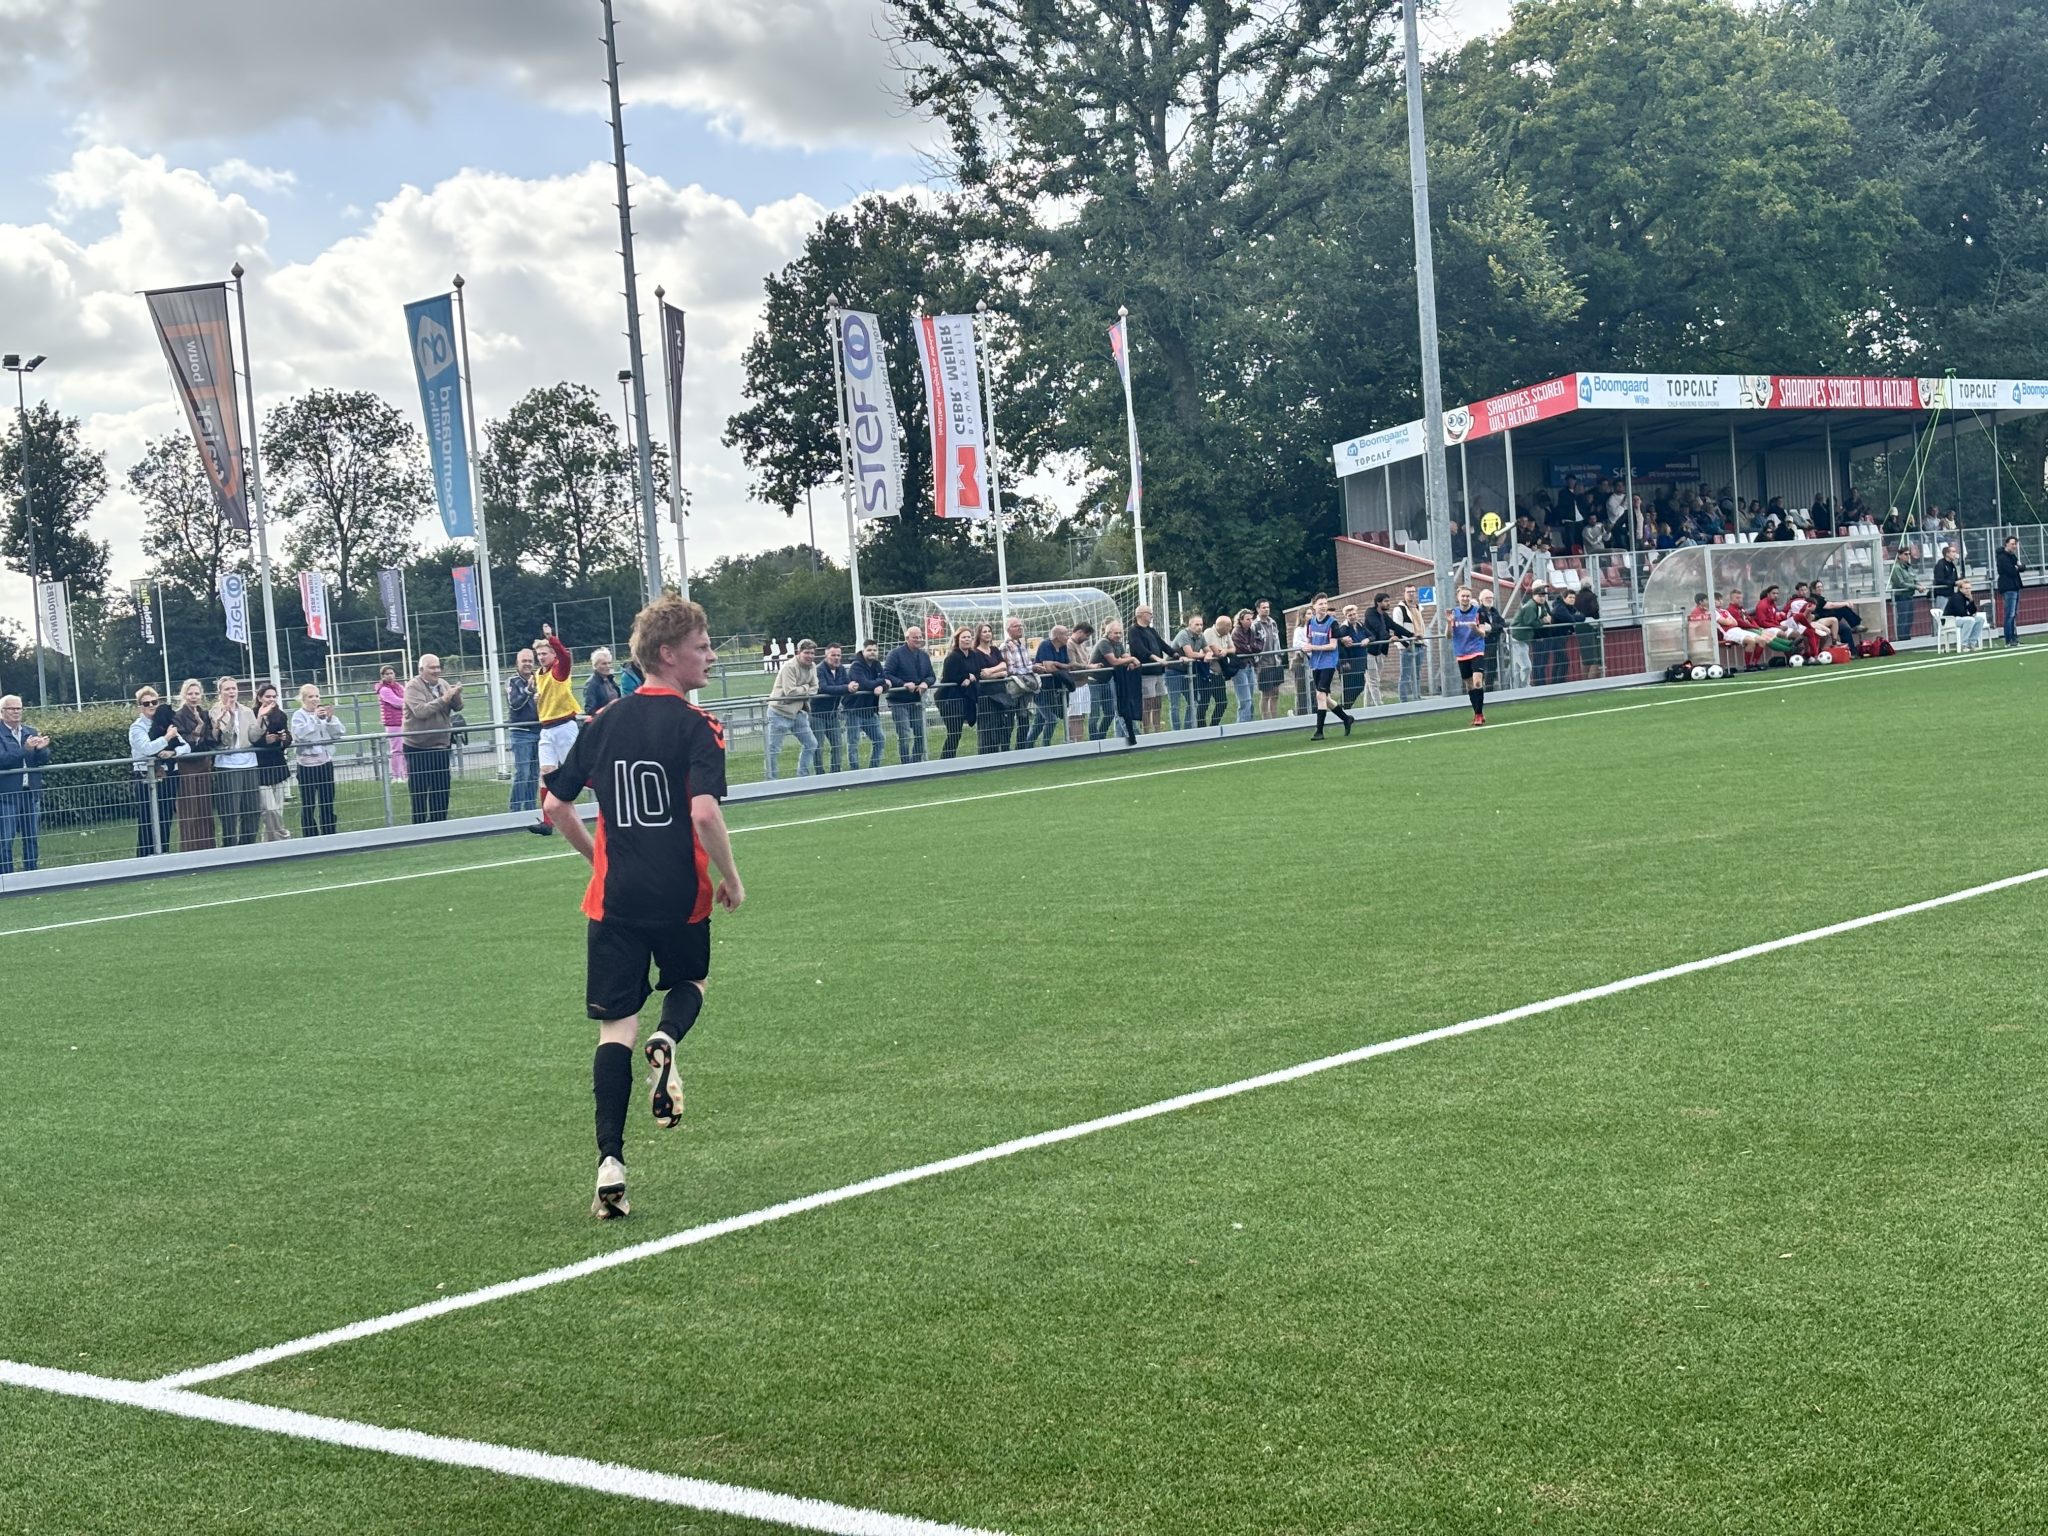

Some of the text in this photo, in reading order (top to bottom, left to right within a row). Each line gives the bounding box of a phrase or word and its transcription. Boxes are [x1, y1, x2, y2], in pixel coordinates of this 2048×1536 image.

[883, 364, 894, 409] Market
[1486, 380, 1565, 416] SAAMPIES SCOREN
[1593, 375, 1649, 396] Boomgaard
[1666, 379, 1719, 397] TOPCALF
[1779, 378, 1913, 407] SAAMPIES SCOREN WIJ ALTIJD!
[1959, 384, 1997, 399] TOPCALF
[889, 412, 898, 441] Food
[1488, 404, 1539, 432] WIJ ALTIJD!
[1359, 427, 1409, 448] Boomgaard
[1354, 450, 1391, 467] TOPCALF
[614, 760, 673, 827] 10
